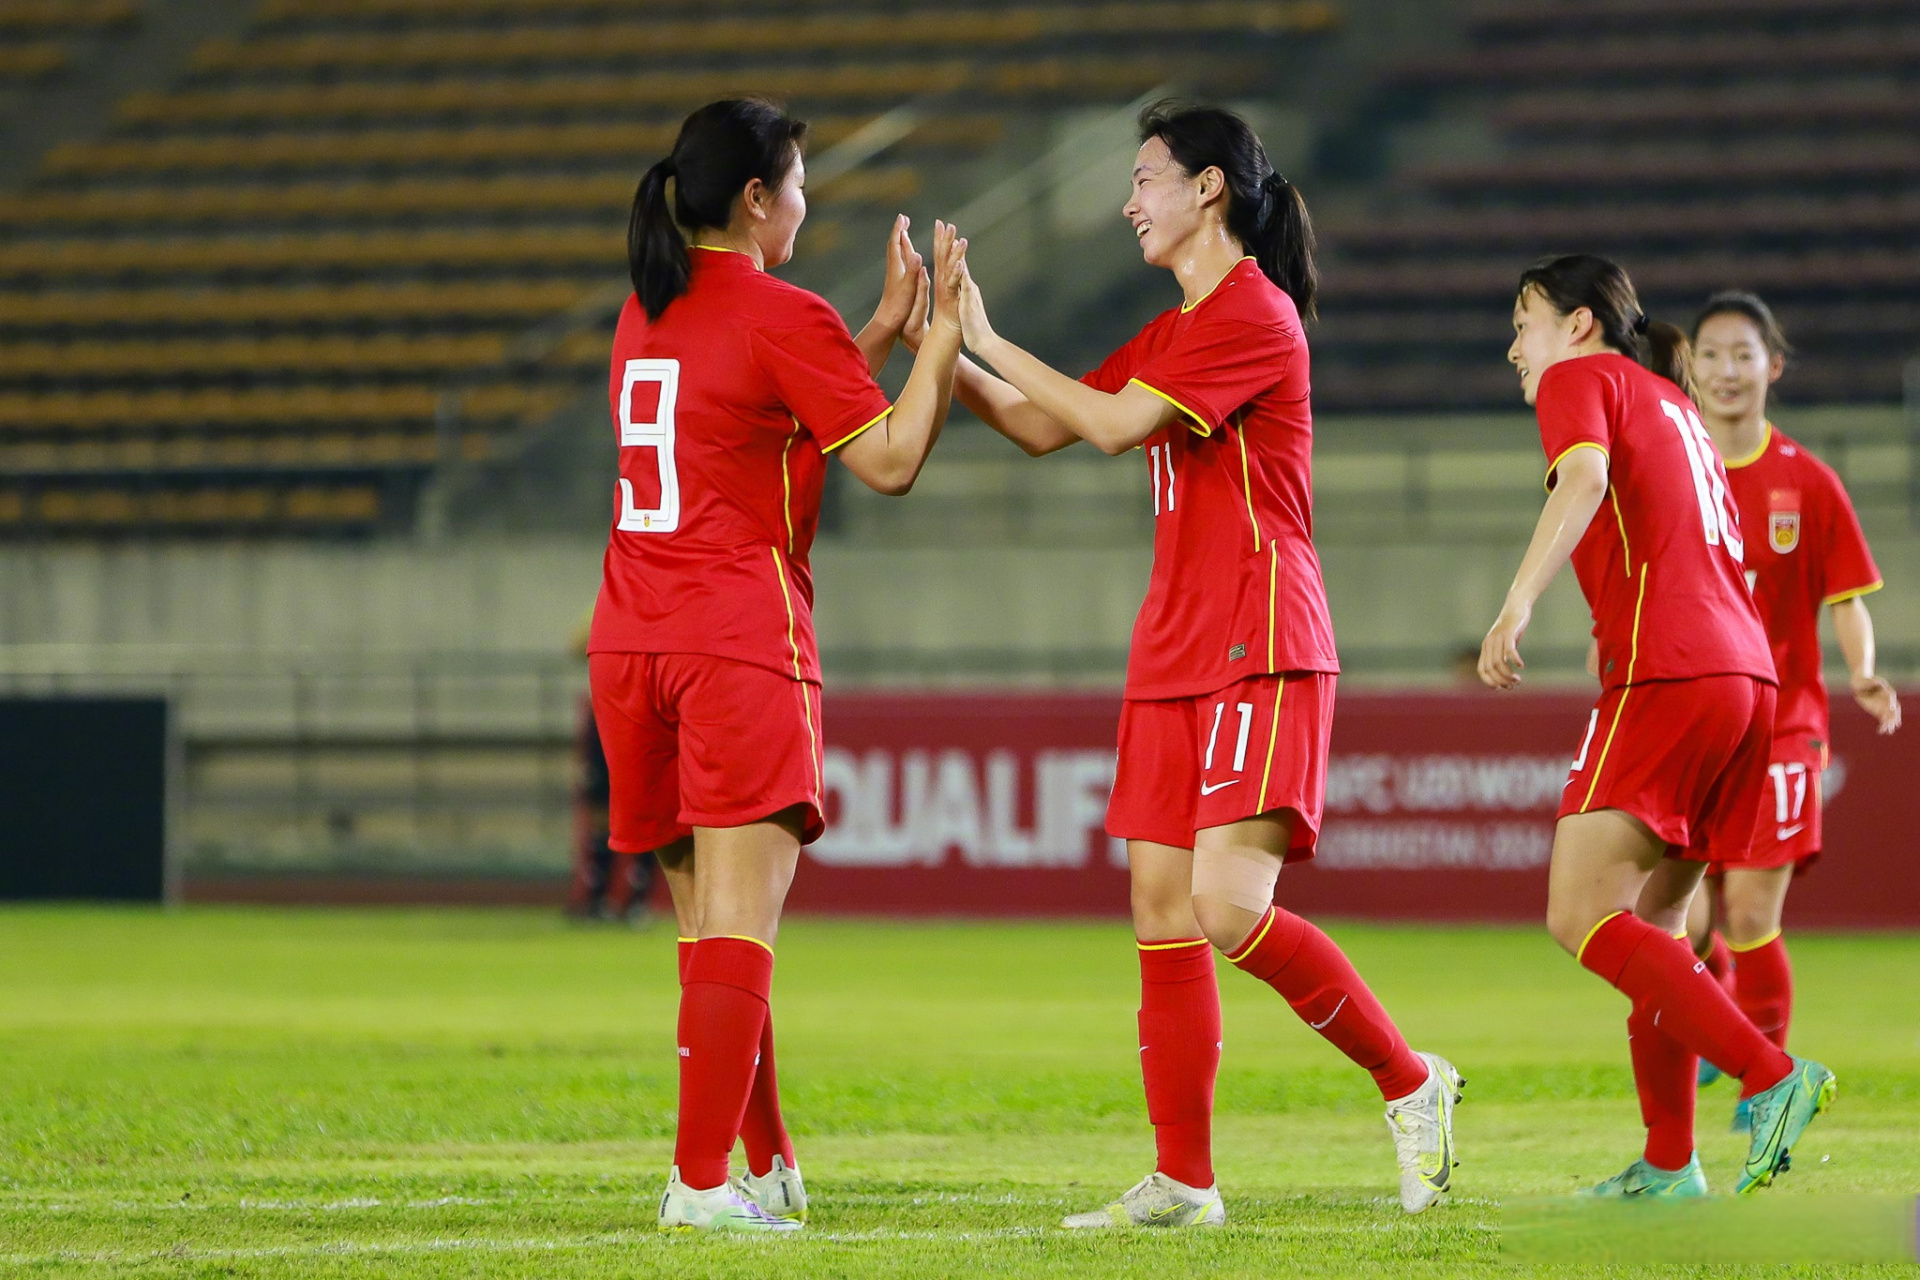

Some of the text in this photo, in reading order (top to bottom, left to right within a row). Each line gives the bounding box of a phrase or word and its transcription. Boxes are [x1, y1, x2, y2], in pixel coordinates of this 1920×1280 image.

[617, 358, 680, 532] 9
[1151, 442, 1175, 516] 11
[1204, 702, 1253, 772] 11
[805, 748, 1129, 868] QUALIF
[1768, 762, 1806, 822] 17
